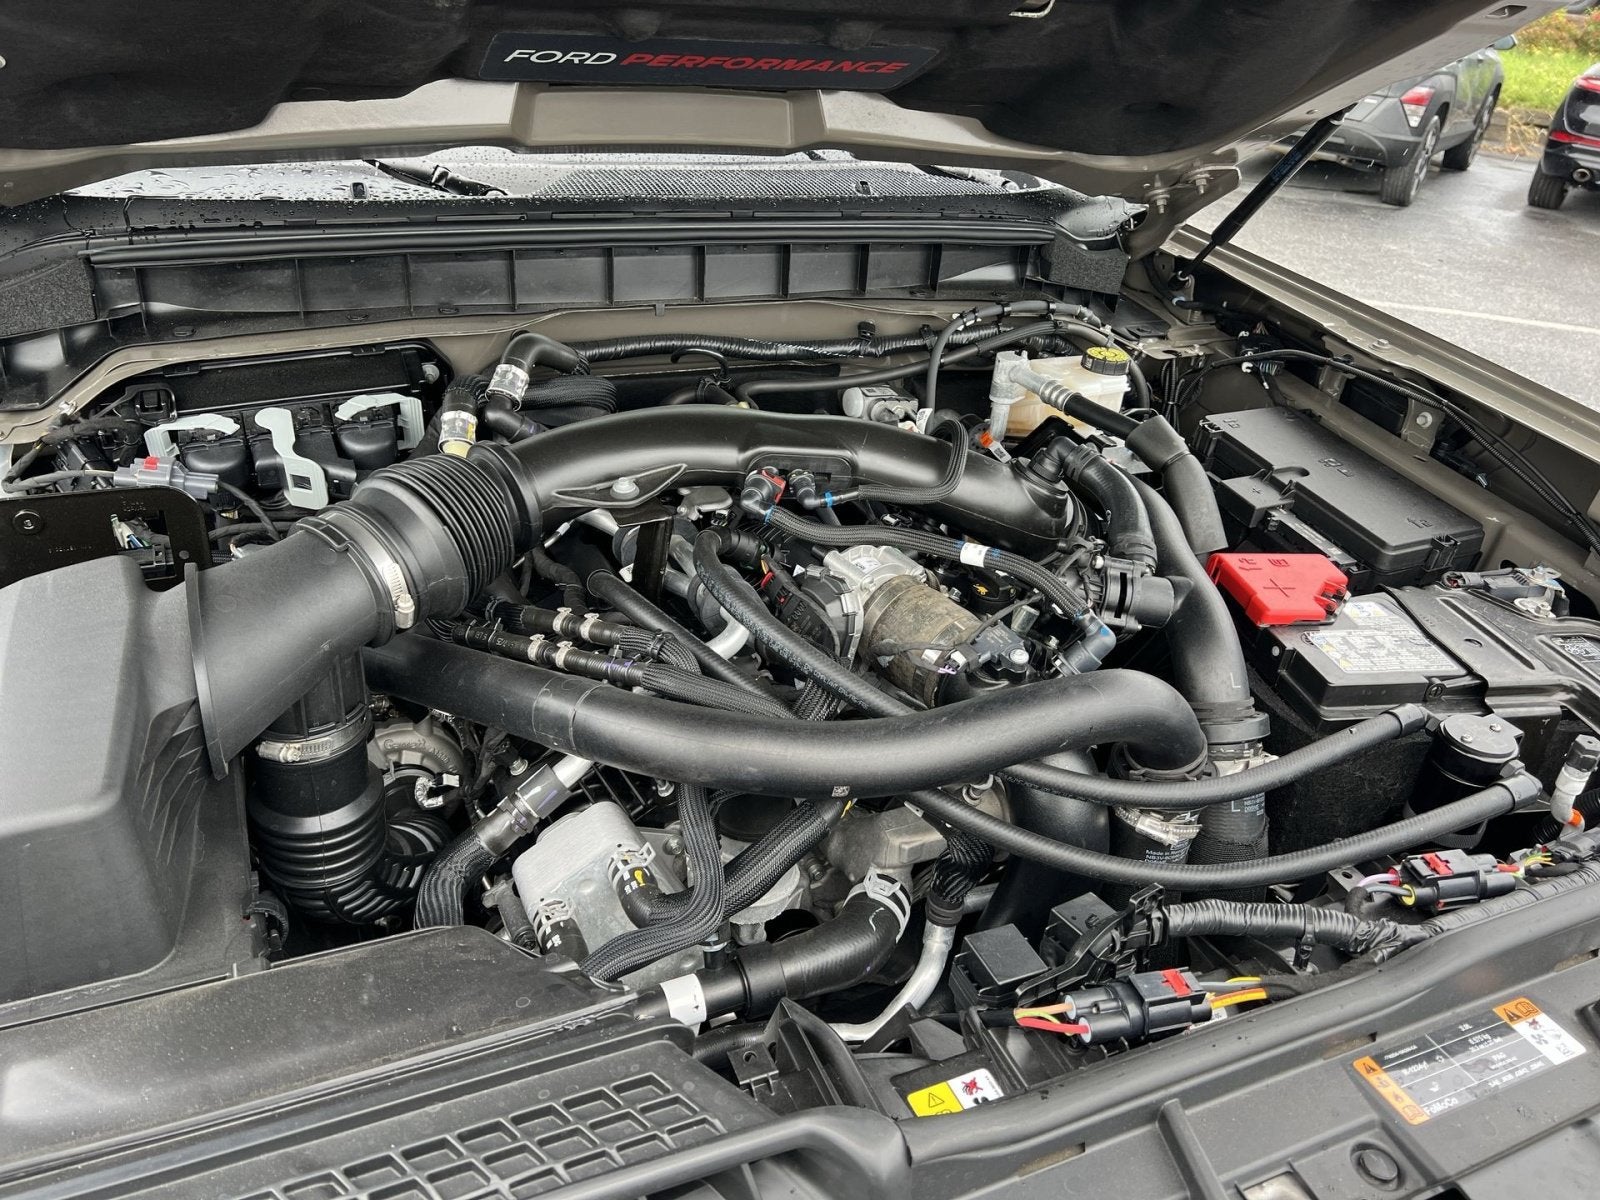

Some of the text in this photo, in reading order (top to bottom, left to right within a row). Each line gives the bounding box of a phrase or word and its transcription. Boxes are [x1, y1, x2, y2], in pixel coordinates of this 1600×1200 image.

[503, 49, 911, 74] FORD PERFORMANCE
[1424, 1097, 1459, 1116] FoMoCo
